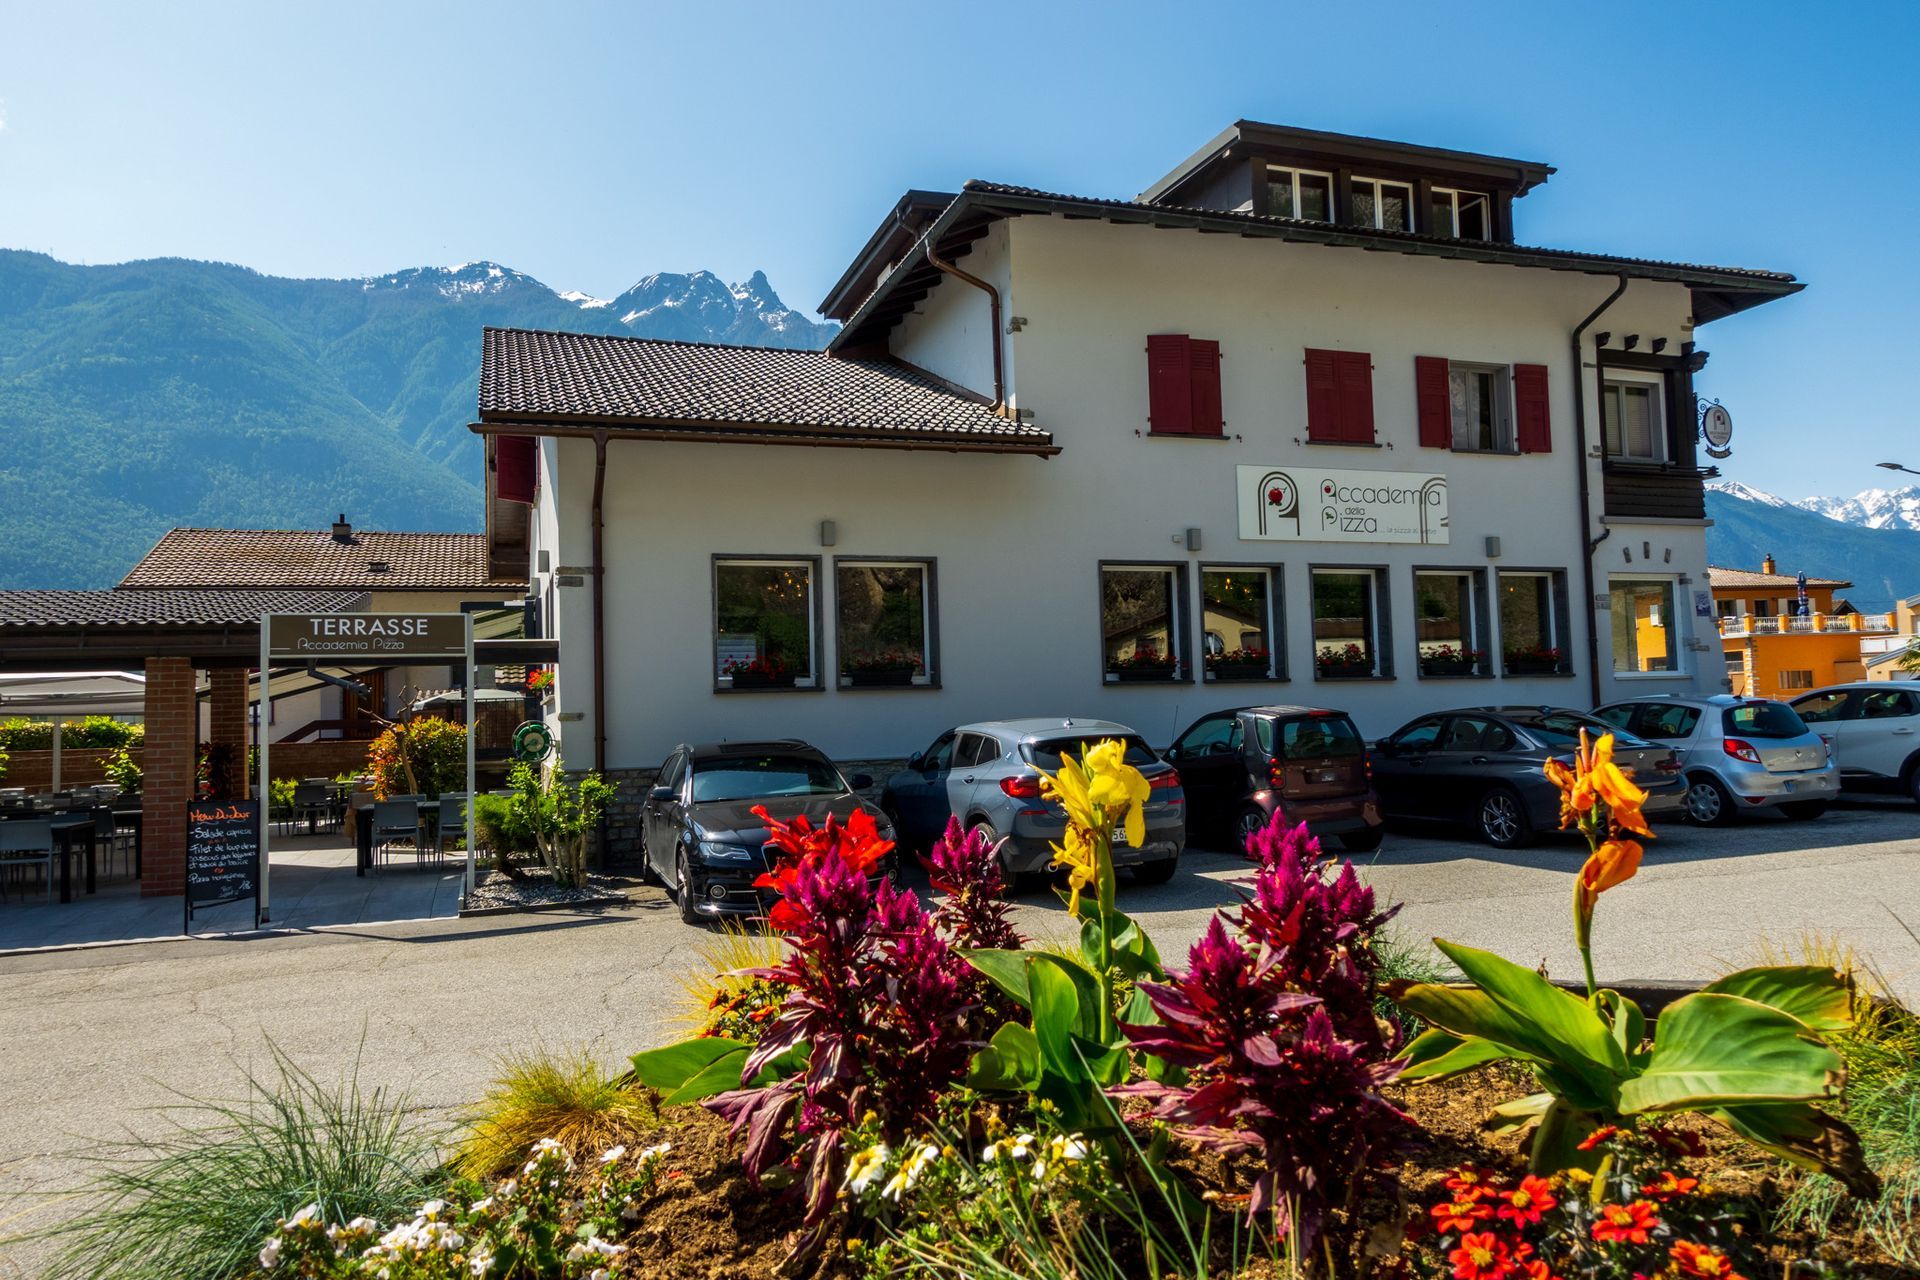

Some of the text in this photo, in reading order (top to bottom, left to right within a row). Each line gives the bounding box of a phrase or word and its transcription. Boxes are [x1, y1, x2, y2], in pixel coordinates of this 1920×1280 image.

[1320, 478, 1440, 506] Accademia
[1321, 505, 1377, 533] Pizza
[309, 618, 429, 636] TERRASSE
[297, 637, 405, 650] Accademia Pizza
